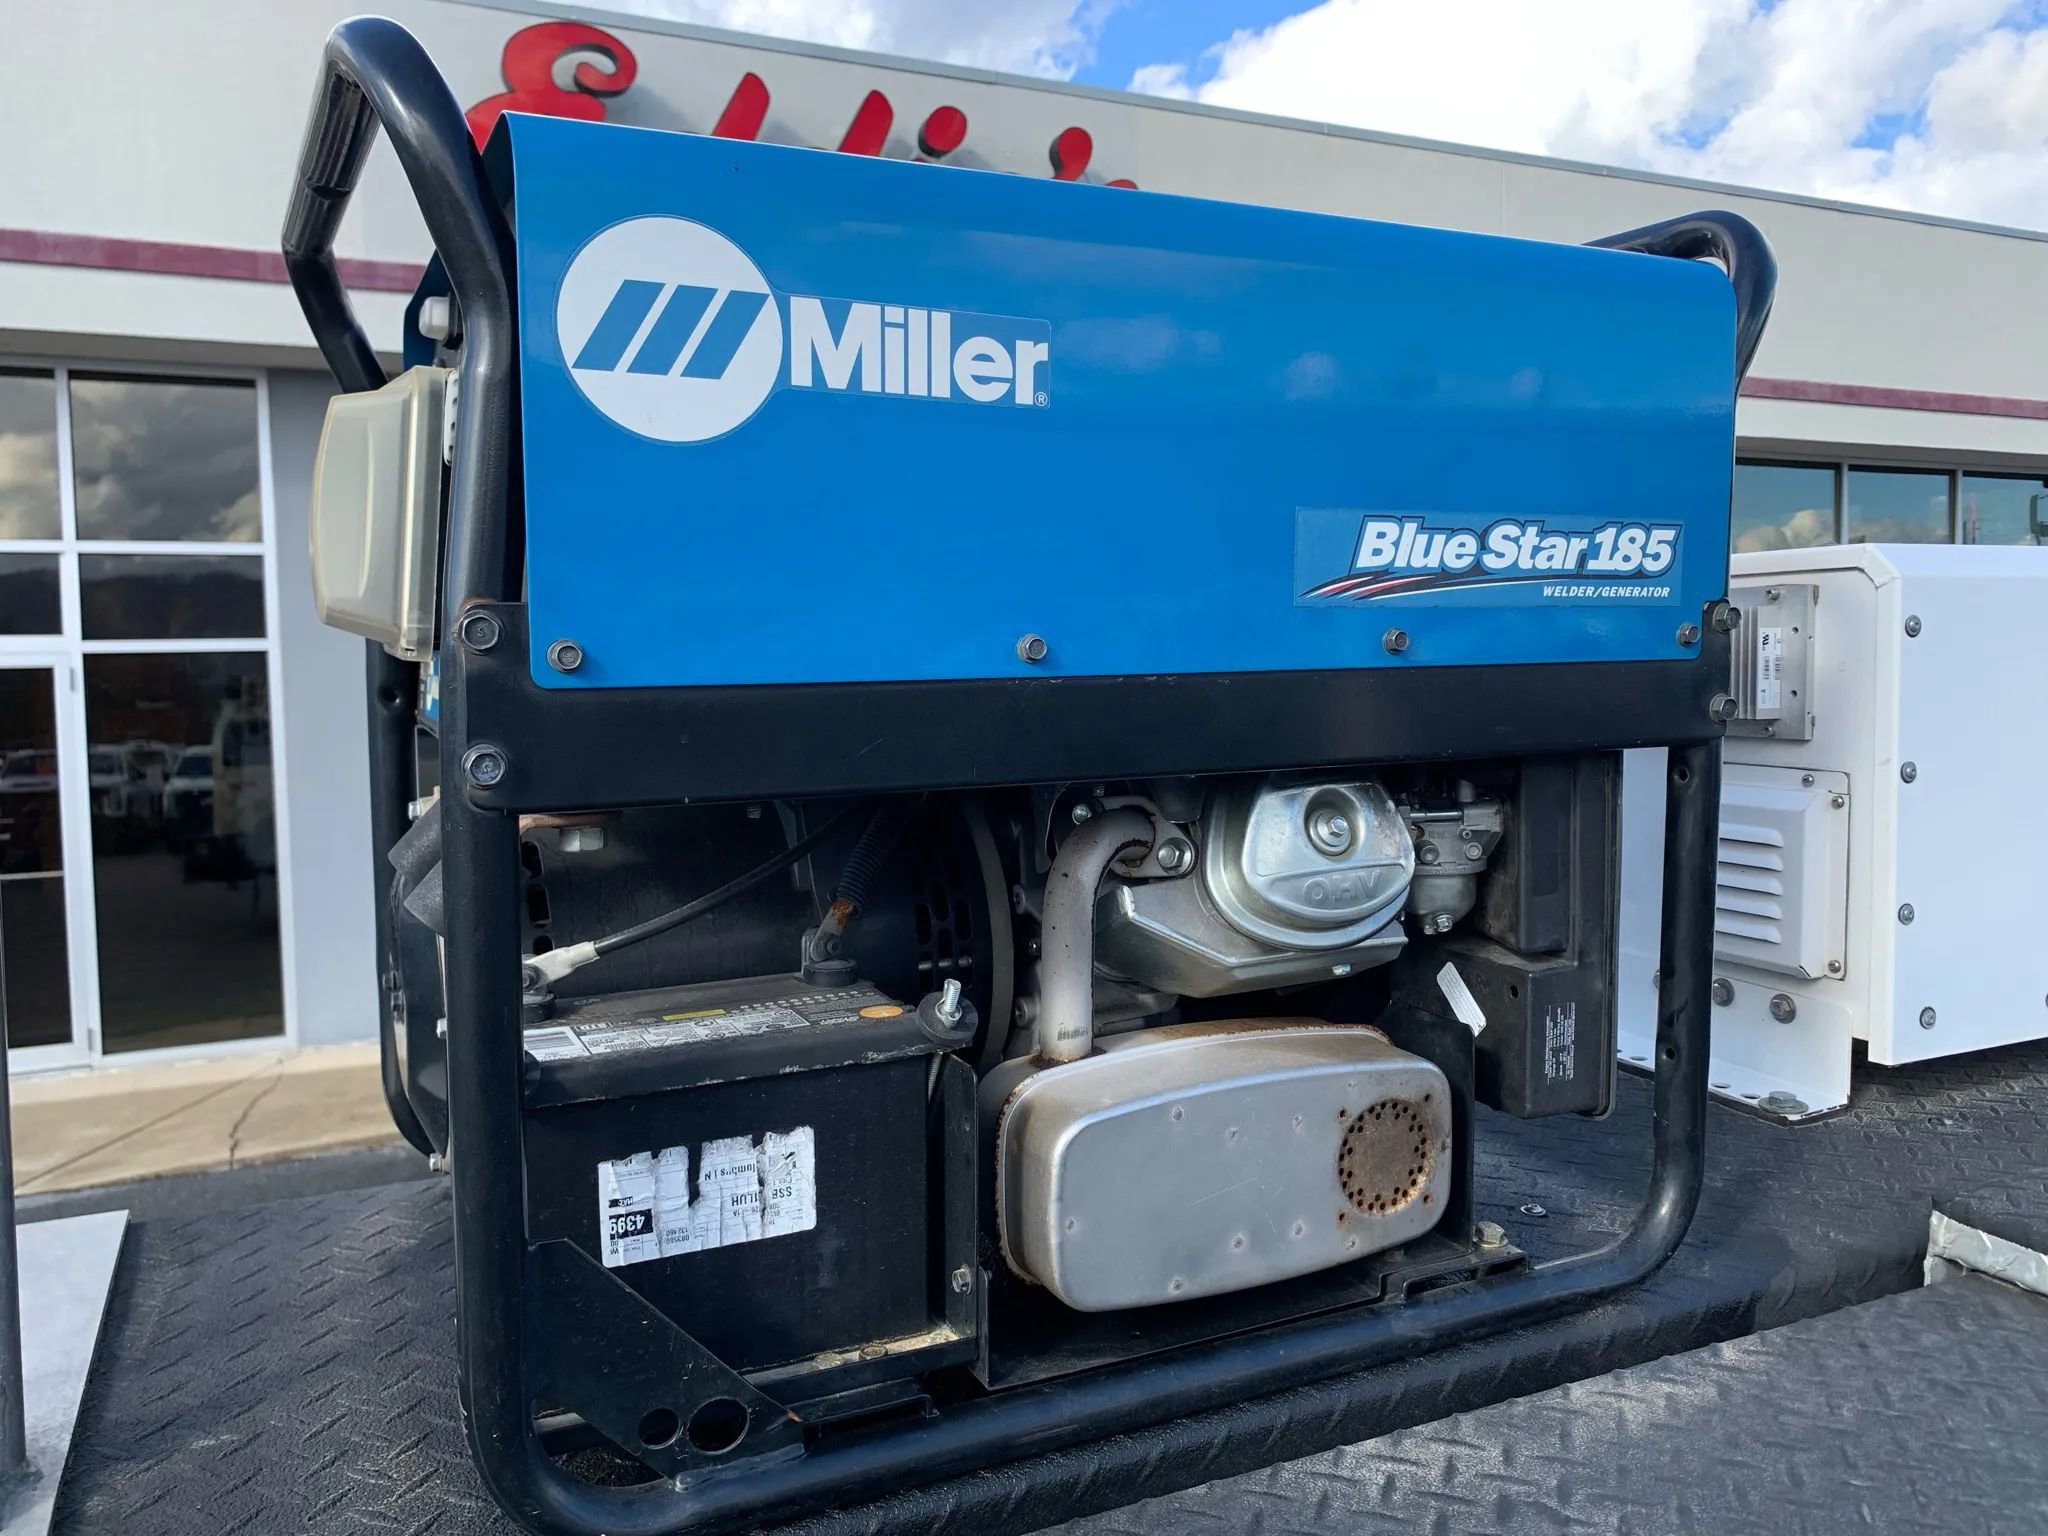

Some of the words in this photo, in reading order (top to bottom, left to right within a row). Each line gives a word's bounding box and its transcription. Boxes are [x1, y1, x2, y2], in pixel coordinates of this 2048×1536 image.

[1356, 521, 1479, 572] Blue
[1482, 524, 1588, 571] Star
[1585, 526, 1676, 572] 185
[1542, 585, 1671, 599] WELDER/GENERATOR
[609, 1213, 645, 1235] 4399
